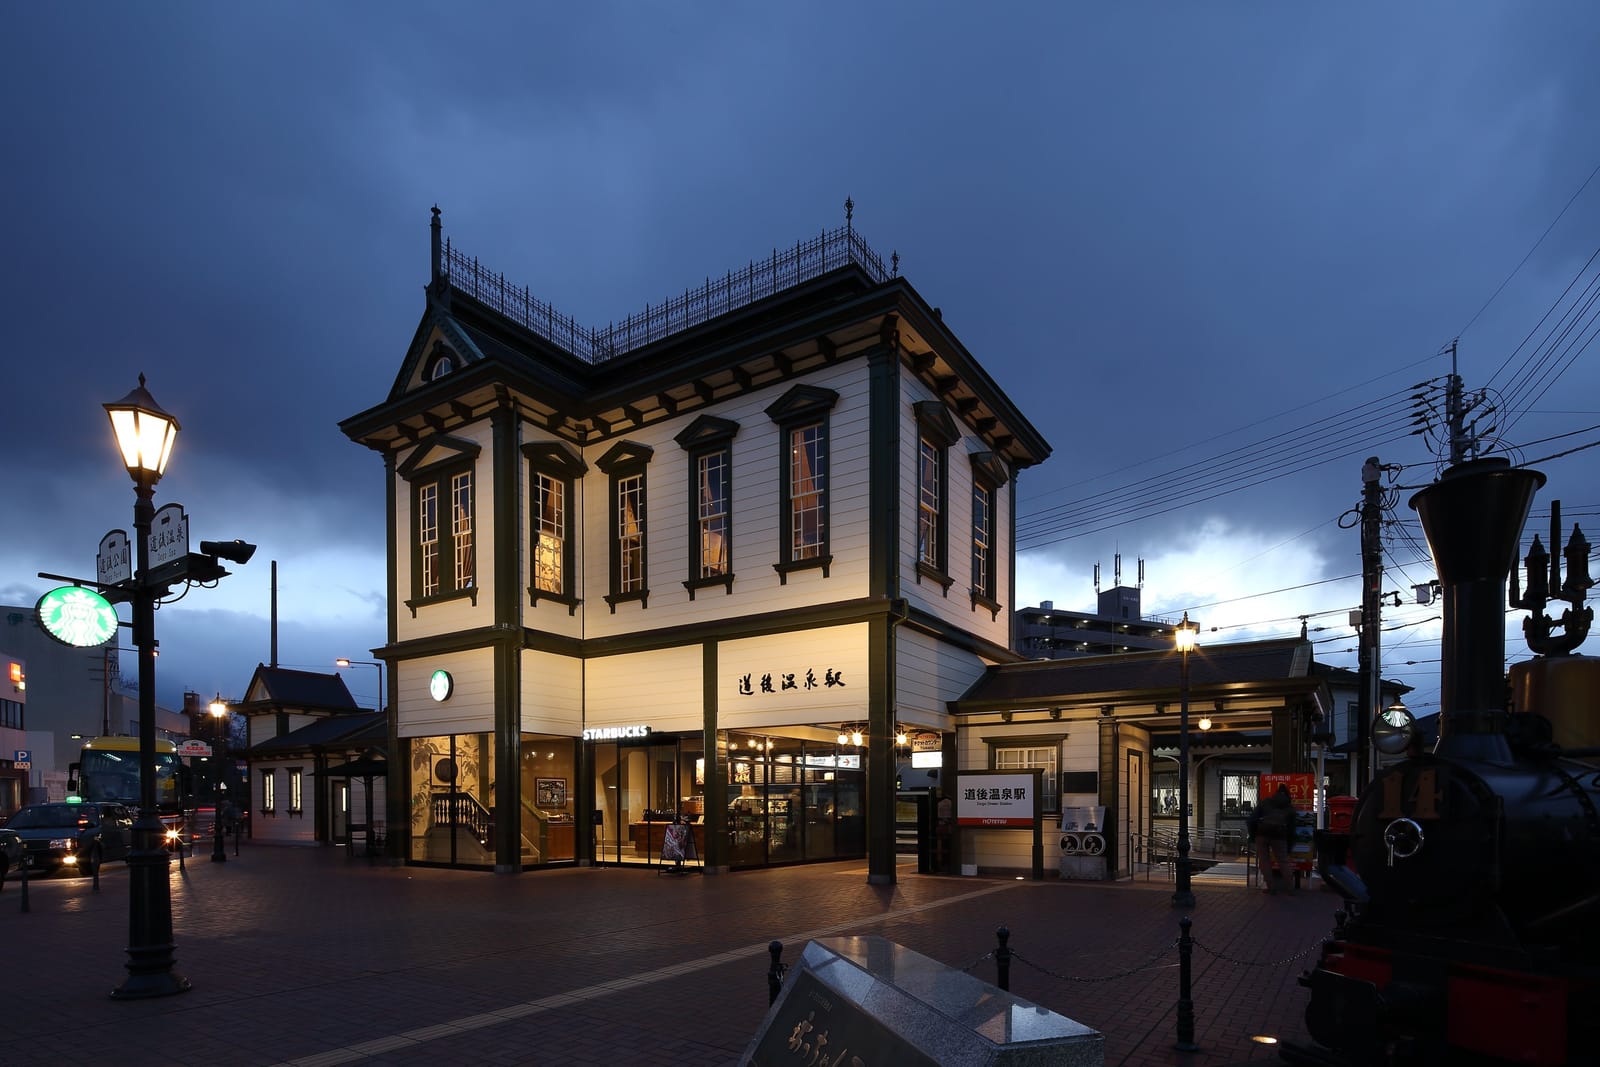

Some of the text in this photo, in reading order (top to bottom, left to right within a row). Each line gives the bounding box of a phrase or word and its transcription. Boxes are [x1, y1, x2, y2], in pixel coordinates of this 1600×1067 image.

[150, 524, 184, 553] 道後温泉
[99, 547, 128, 574] 道後公園
[739, 668, 846, 695] 道後温泉駅
[583, 726, 647, 740] STARBUCKS
[18, 751, 27, 761] P
[964, 788, 1026, 801] 道後温泉駅
[1376, 769, 1445, 820] 14
